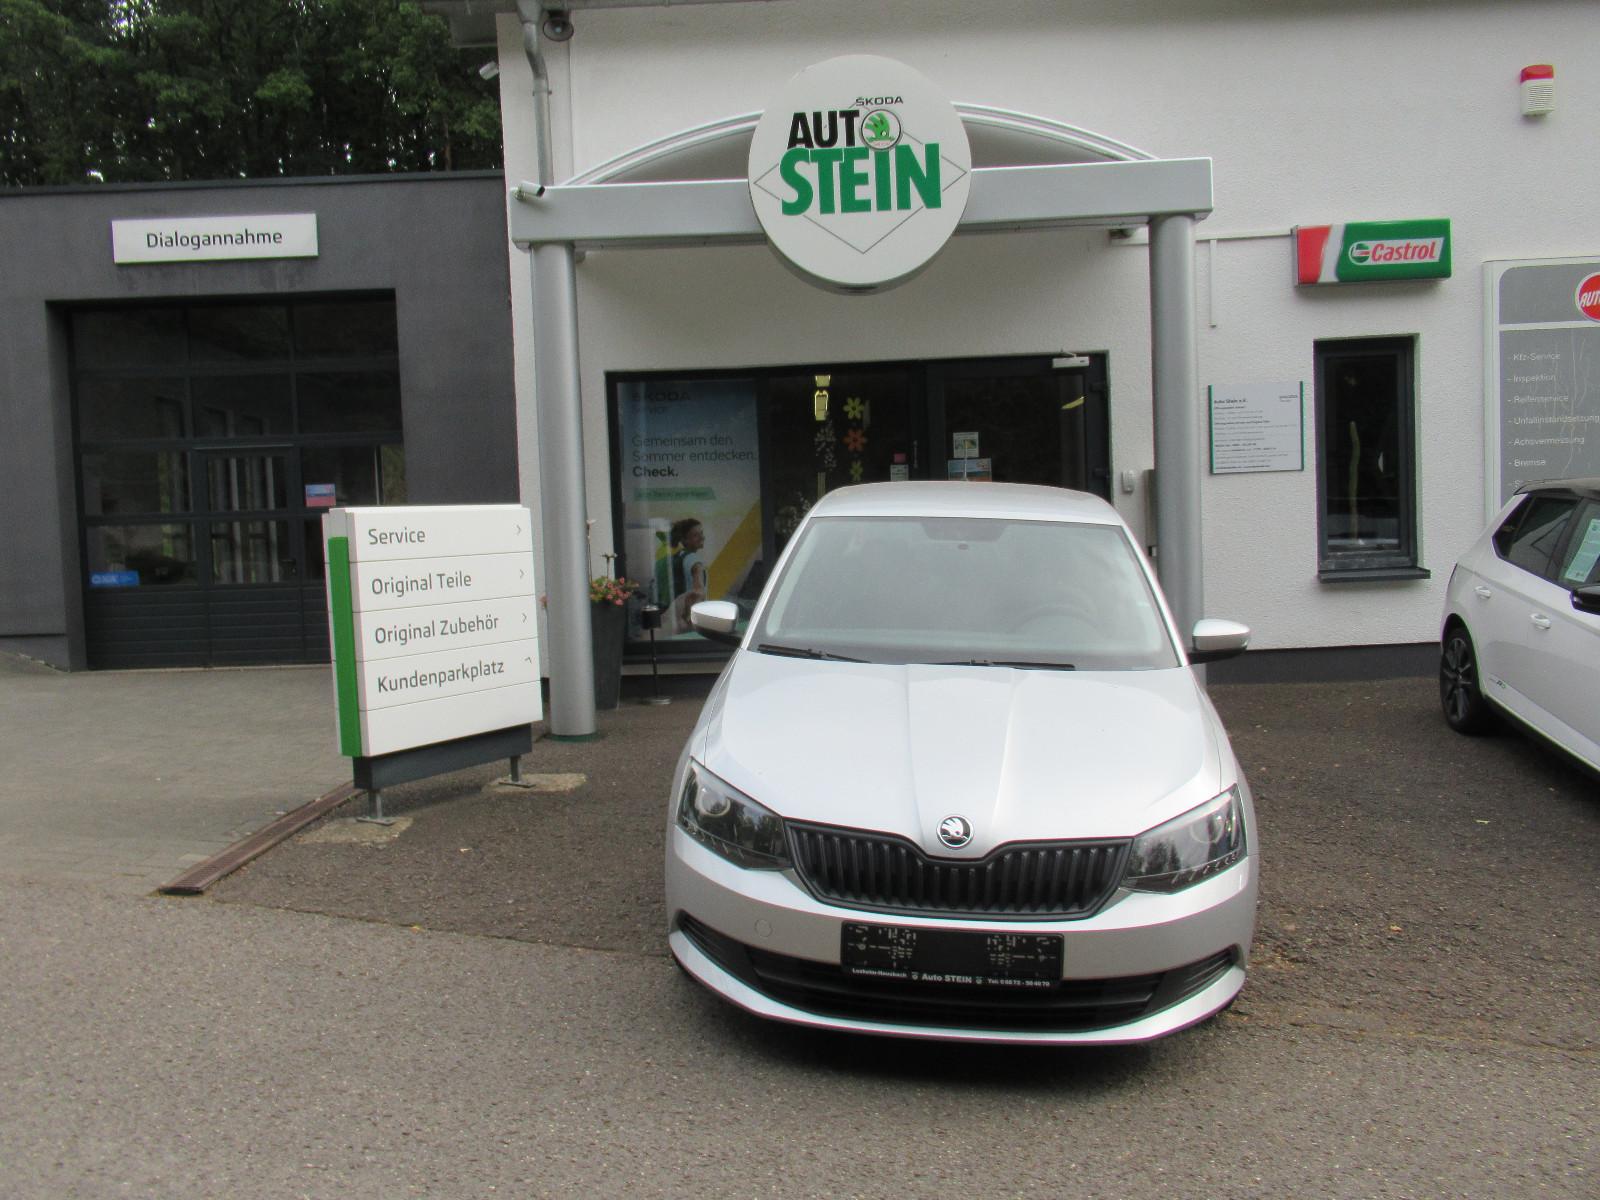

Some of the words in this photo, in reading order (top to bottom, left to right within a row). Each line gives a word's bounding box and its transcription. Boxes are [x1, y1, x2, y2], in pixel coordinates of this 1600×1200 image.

[779, 143, 942, 216] STEIN
[146, 229, 283, 251] Dialogannahme
[1371, 241, 1437, 262] Castrol
[1579, 289, 1600, 308] AUT
[1513, 374, 1556, 384] Inspektion
[632, 435, 706, 447] Gemeinsam
[709, 434, 734, 447] den
[632, 450, 686, 463] Sommer
[632, 465, 679, 478] Check.
[368, 526, 426, 545] Service
[371, 573, 433, 597] Original
[436, 570, 472, 589] Teile
[375, 620, 435, 645] Original
[439, 614, 499, 636] Zubehör
[377, 660, 505, 693] Kundenparkplatz
[921, 973, 943, 983] Auto
[944, 974, 973, 984] STEIN
